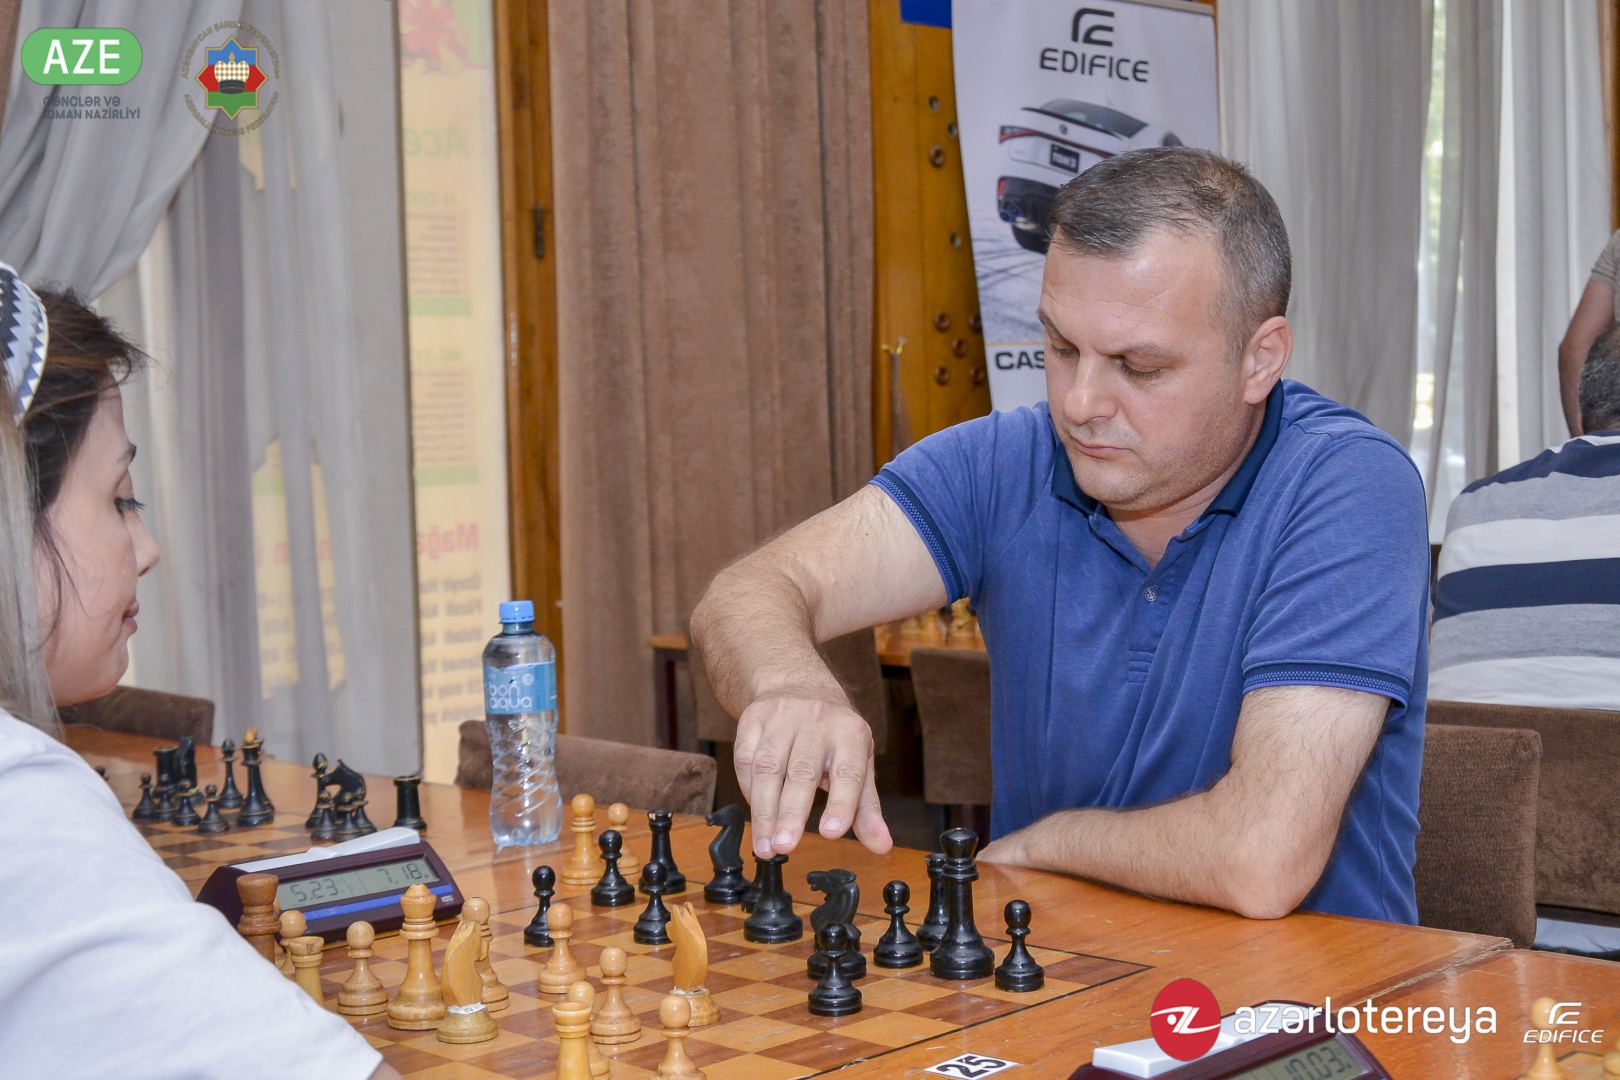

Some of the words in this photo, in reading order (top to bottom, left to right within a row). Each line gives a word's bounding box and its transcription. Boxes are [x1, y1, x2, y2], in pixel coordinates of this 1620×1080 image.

[1039, 47, 1150, 83] EDIFICE
[489, 696, 532, 712] aqua
[936, 1055, 1007, 1079] 25
